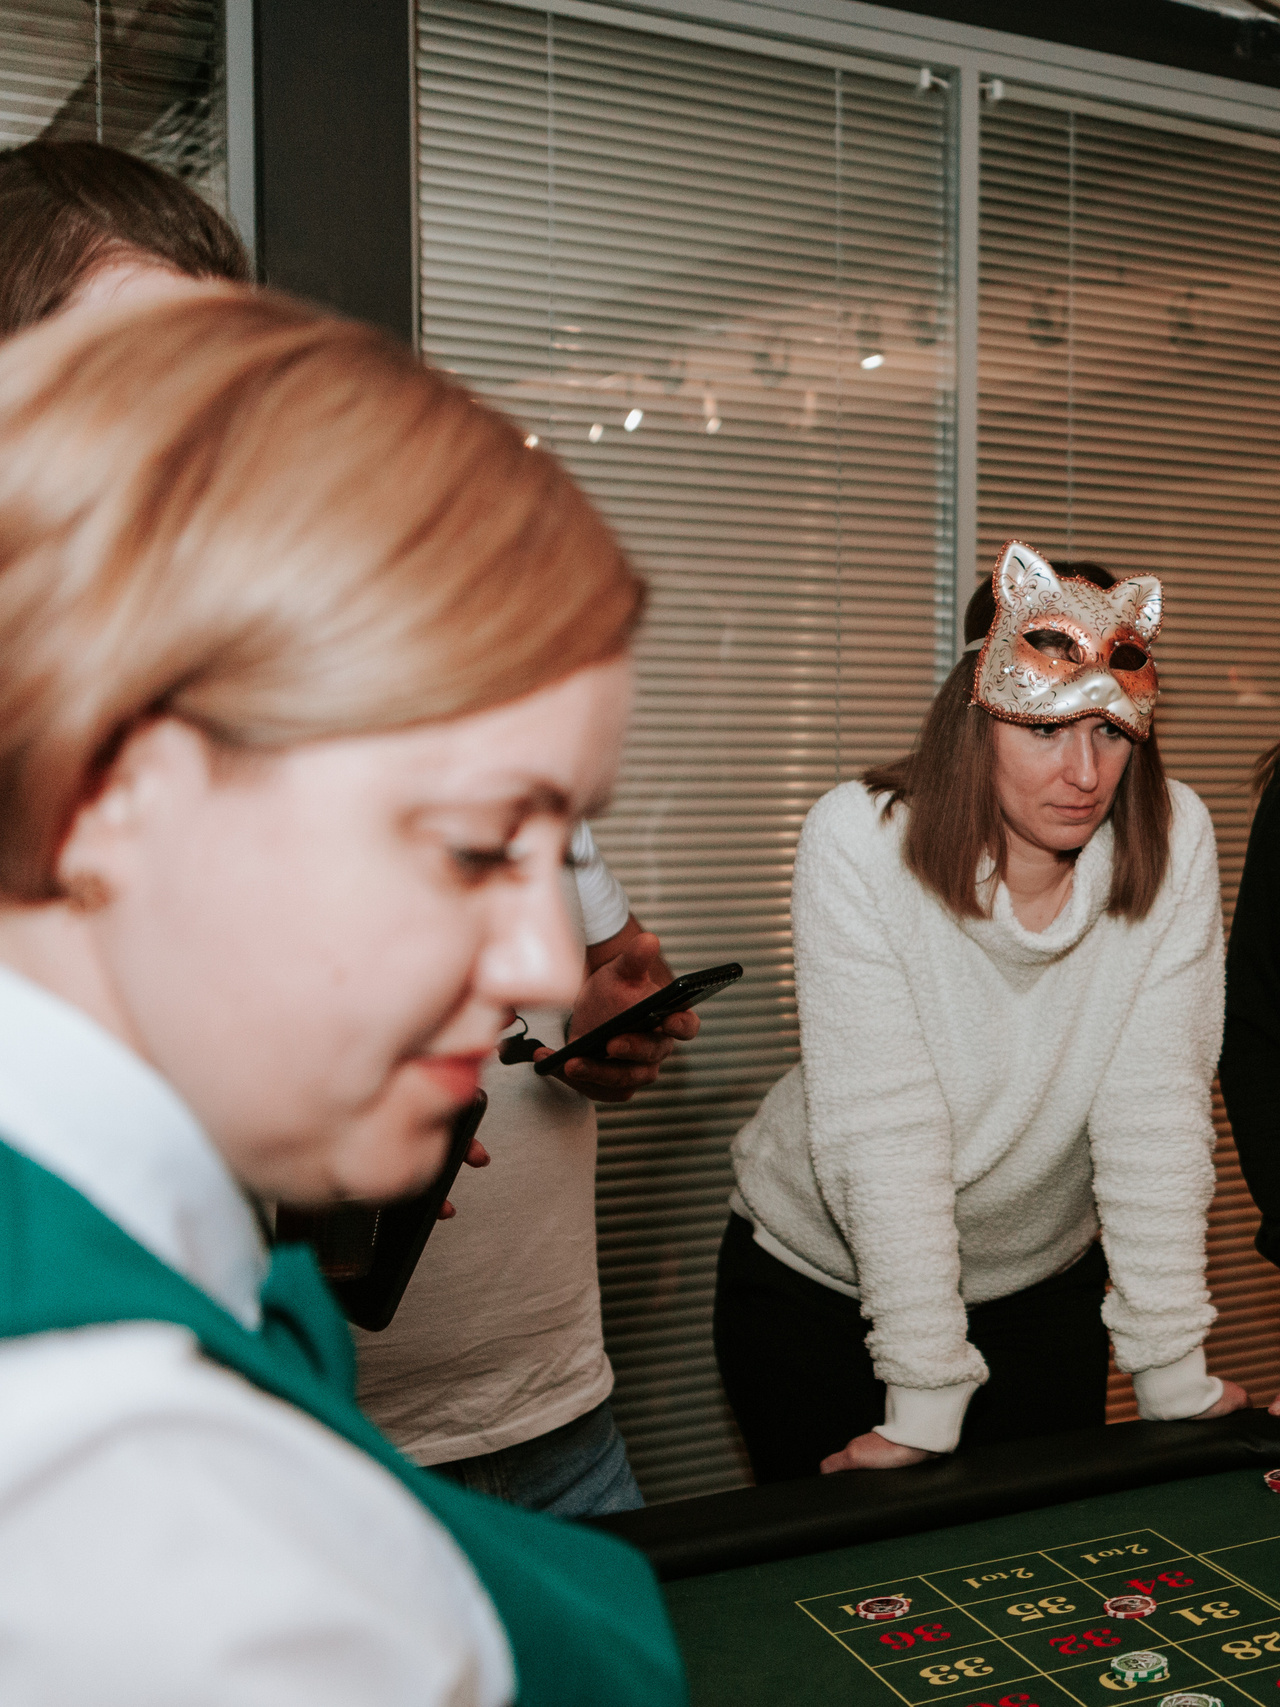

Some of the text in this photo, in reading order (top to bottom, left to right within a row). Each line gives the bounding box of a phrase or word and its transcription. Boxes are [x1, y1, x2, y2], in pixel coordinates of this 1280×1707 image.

[1123, 1571, 1194, 1595] 34
[1006, 1596, 1076, 1622] 35
[1169, 1601, 1240, 1626] 31
[879, 1623, 951, 1650] 36
[1048, 1628, 1121, 1654] 32
[919, 1656, 994, 1685] 33
